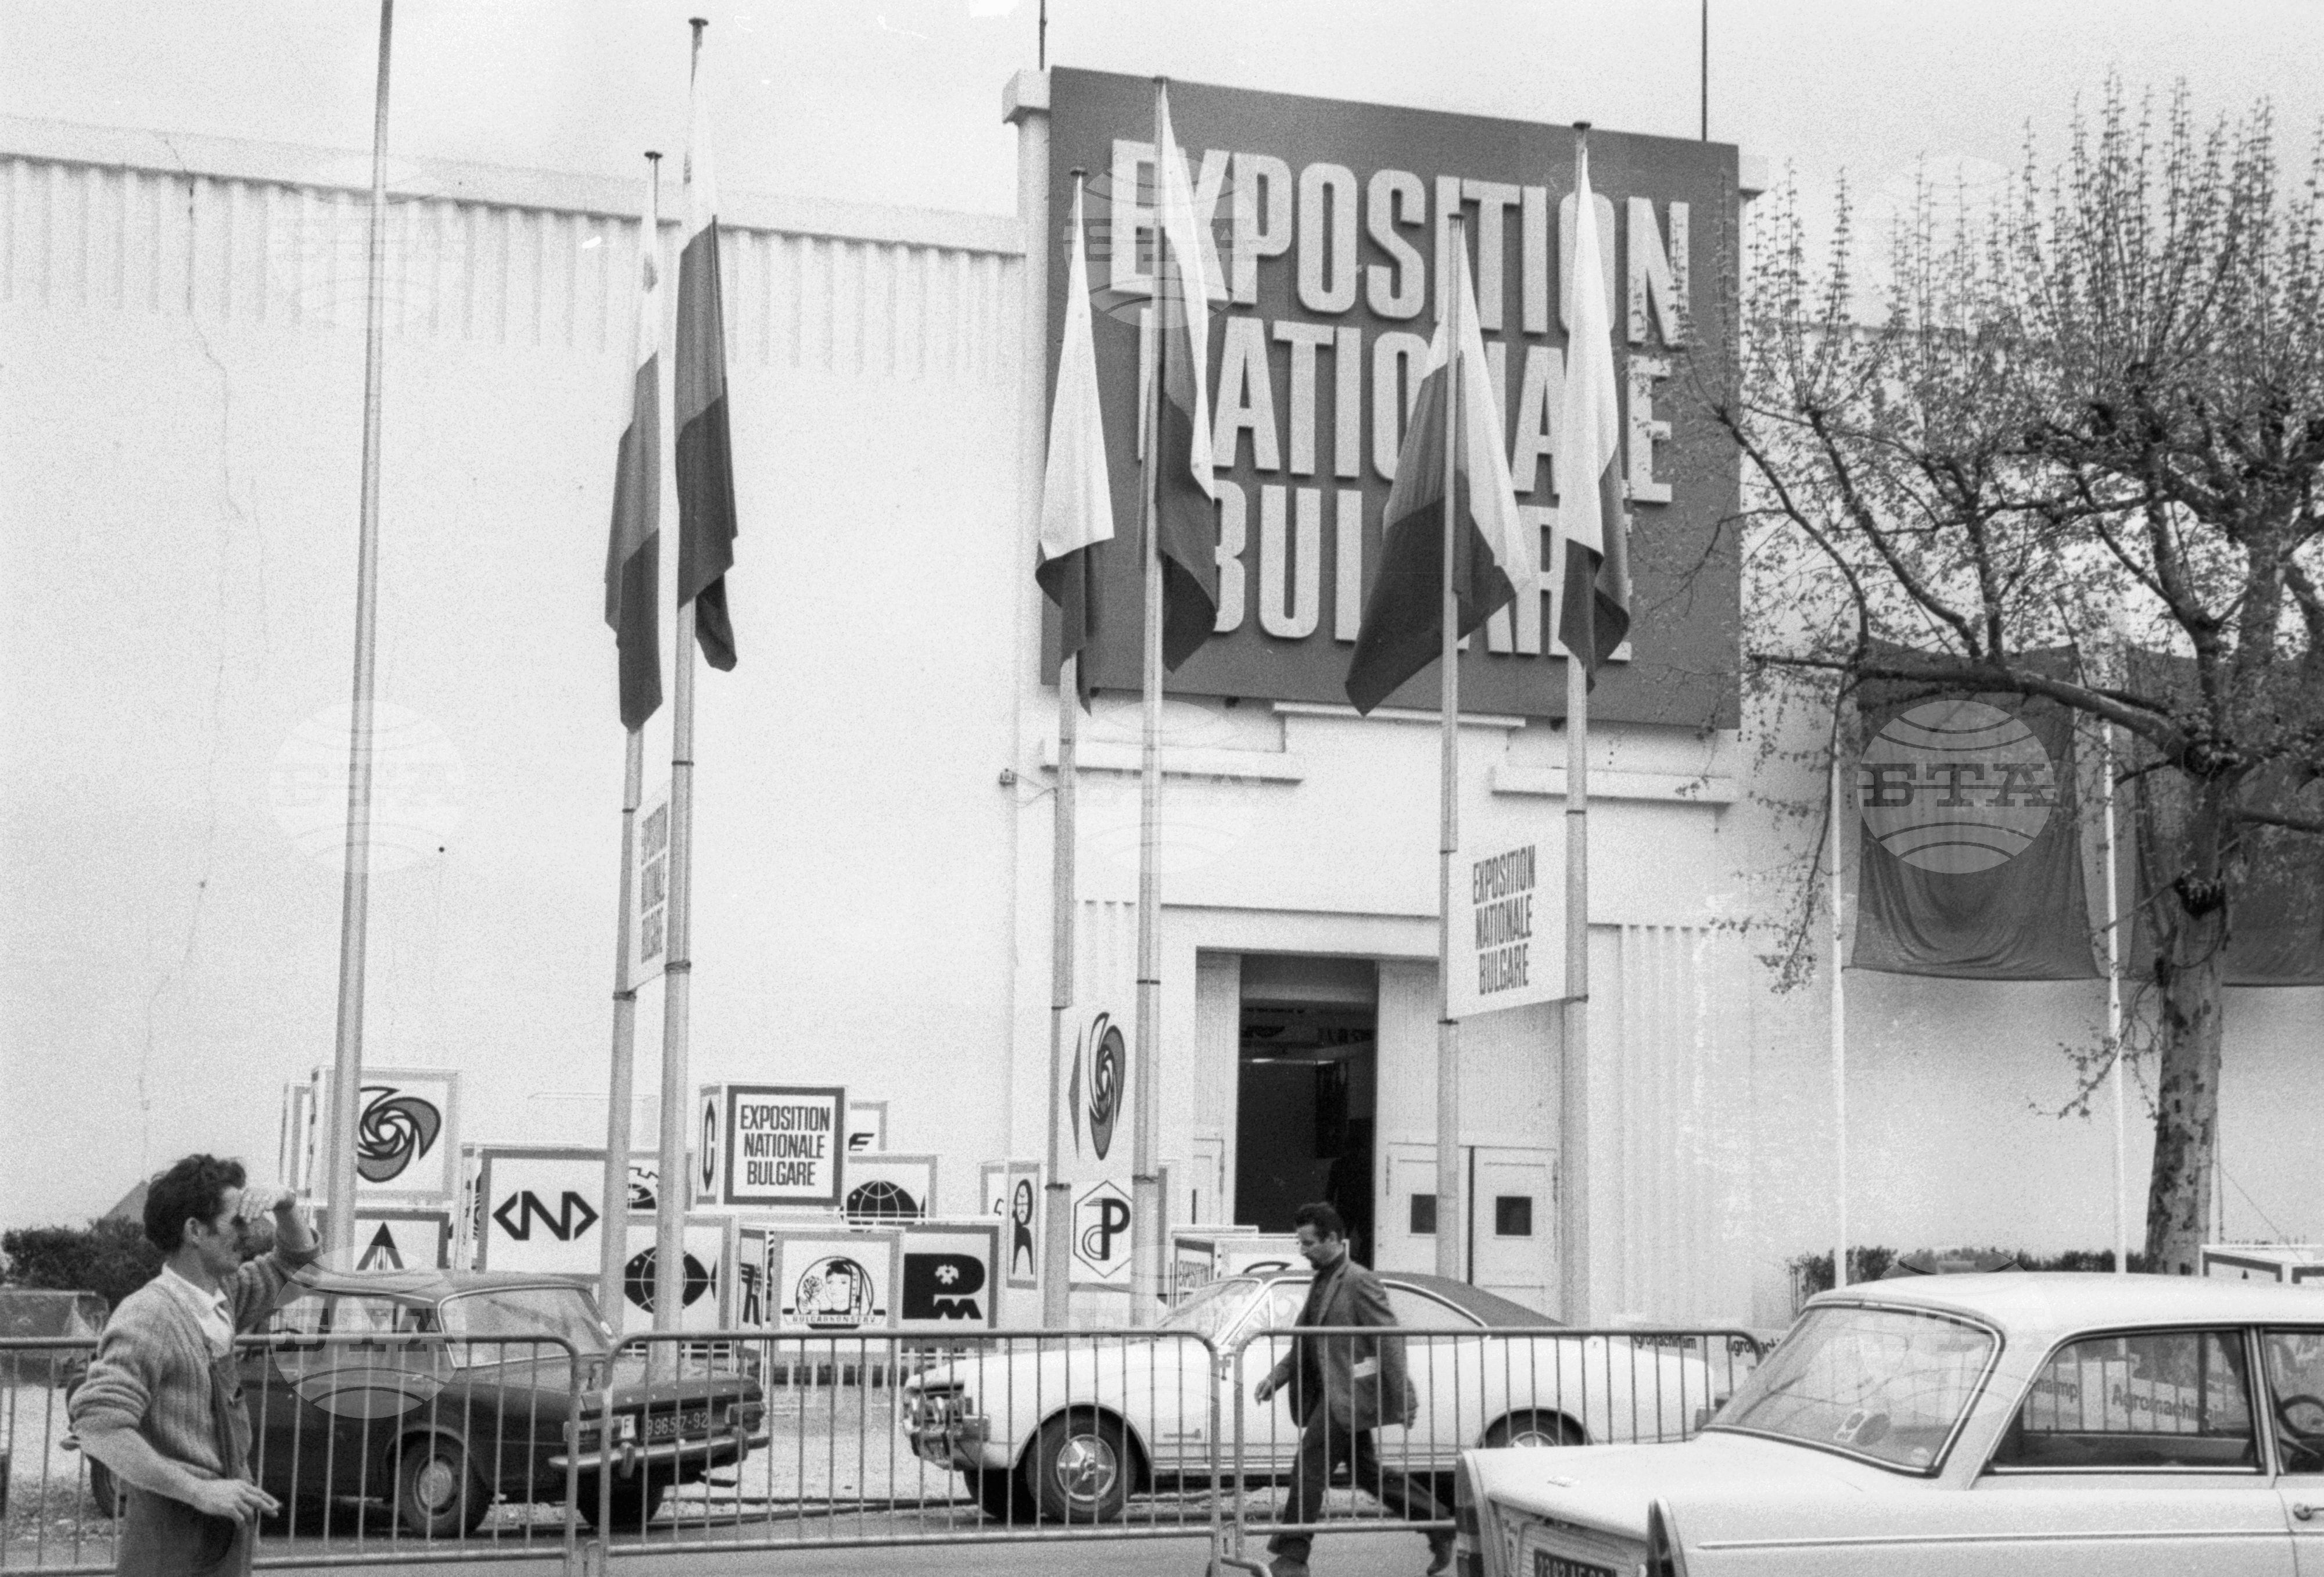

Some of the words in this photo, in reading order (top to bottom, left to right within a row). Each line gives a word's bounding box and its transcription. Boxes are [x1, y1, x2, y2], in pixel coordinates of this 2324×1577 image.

[1137, 307, 1672, 503] ATIOAE
[1473, 844, 1536, 905] EXPOSITION
[1476, 893, 1533, 951] NATIONALE
[1479, 942, 1529, 996] BULGARE
[740, 1105, 830, 1131] EXPOSITION
[744, 1132, 826, 1159] NATIONALE
[747, 1160, 816, 1186] BULGARE
